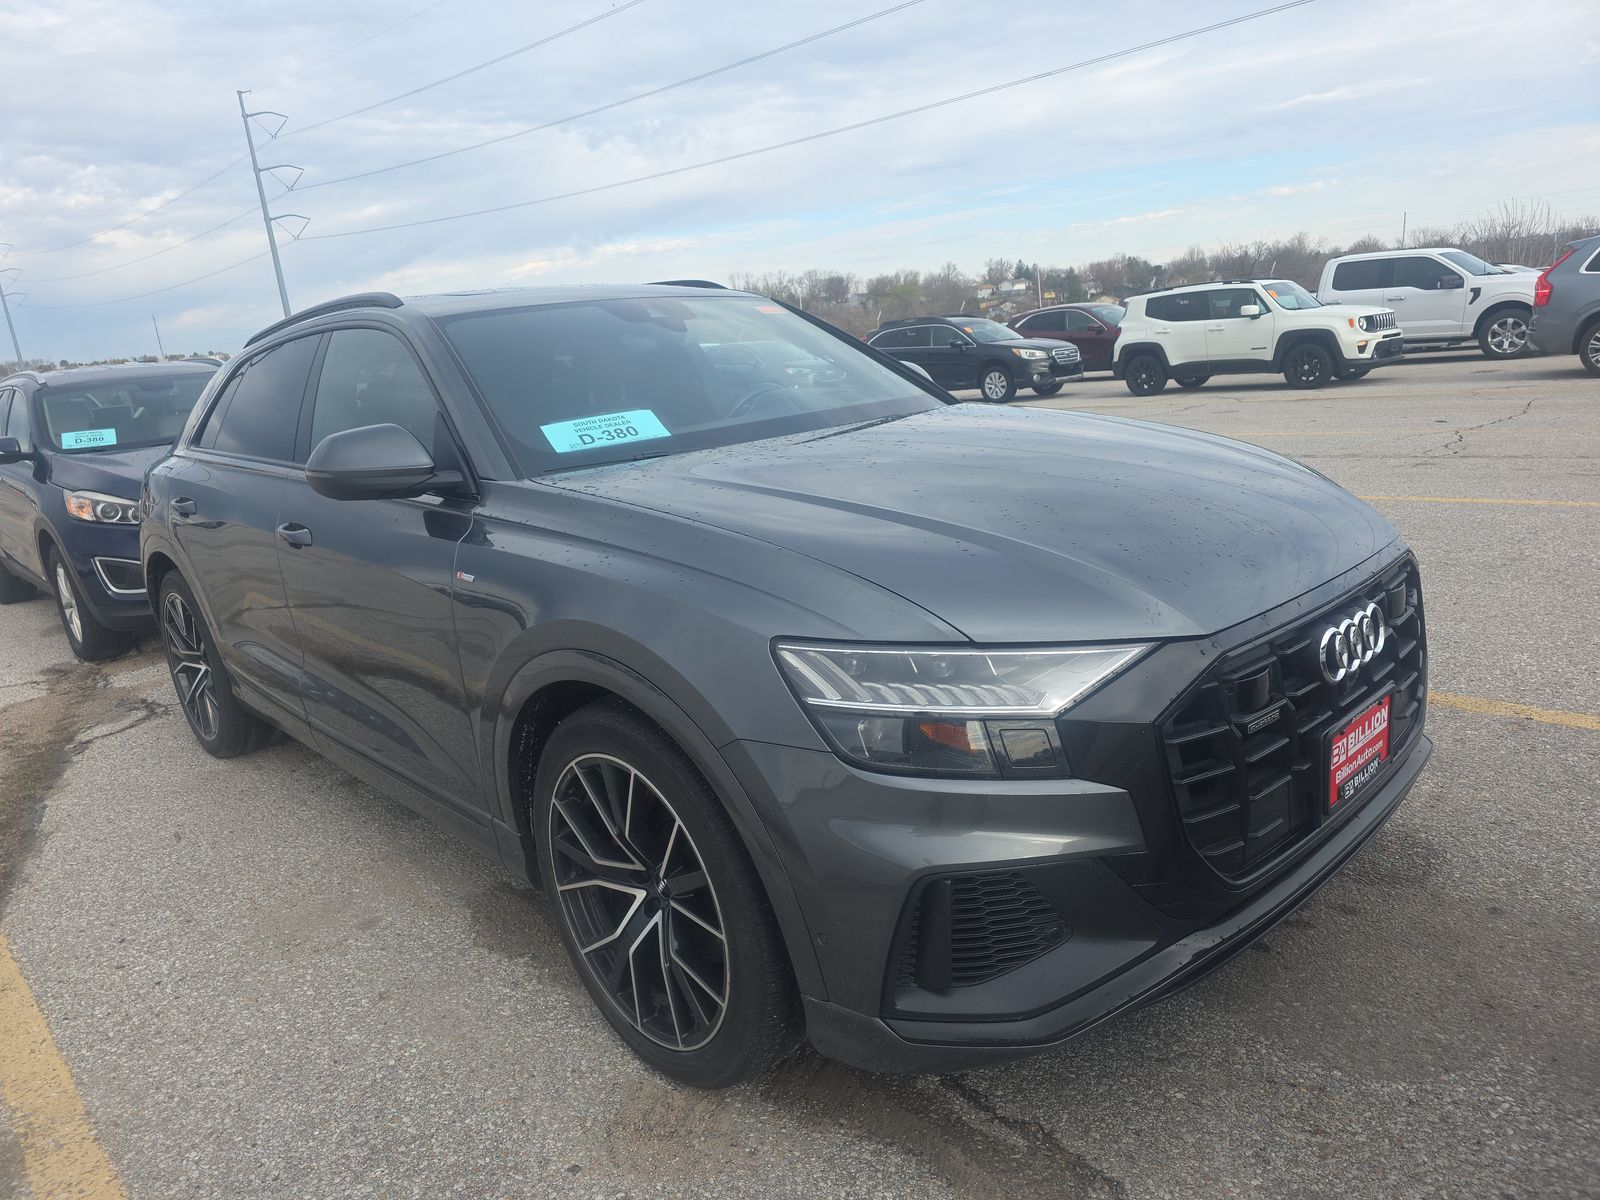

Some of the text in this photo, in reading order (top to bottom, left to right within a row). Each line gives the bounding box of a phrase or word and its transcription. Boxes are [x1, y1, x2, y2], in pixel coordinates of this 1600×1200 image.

[573, 415, 626, 428] SOUTH DAKOTA
[574, 420, 631, 433] VEHICLE DEALER
[75, 436, 104, 444] D-380
[578, 426, 639, 445] D-380
[1347, 705, 1388, 750] BILLION
[1335, 740, 1383, 784] BillionAuto.com
[1354, 757, 1379, 787] BILLION
